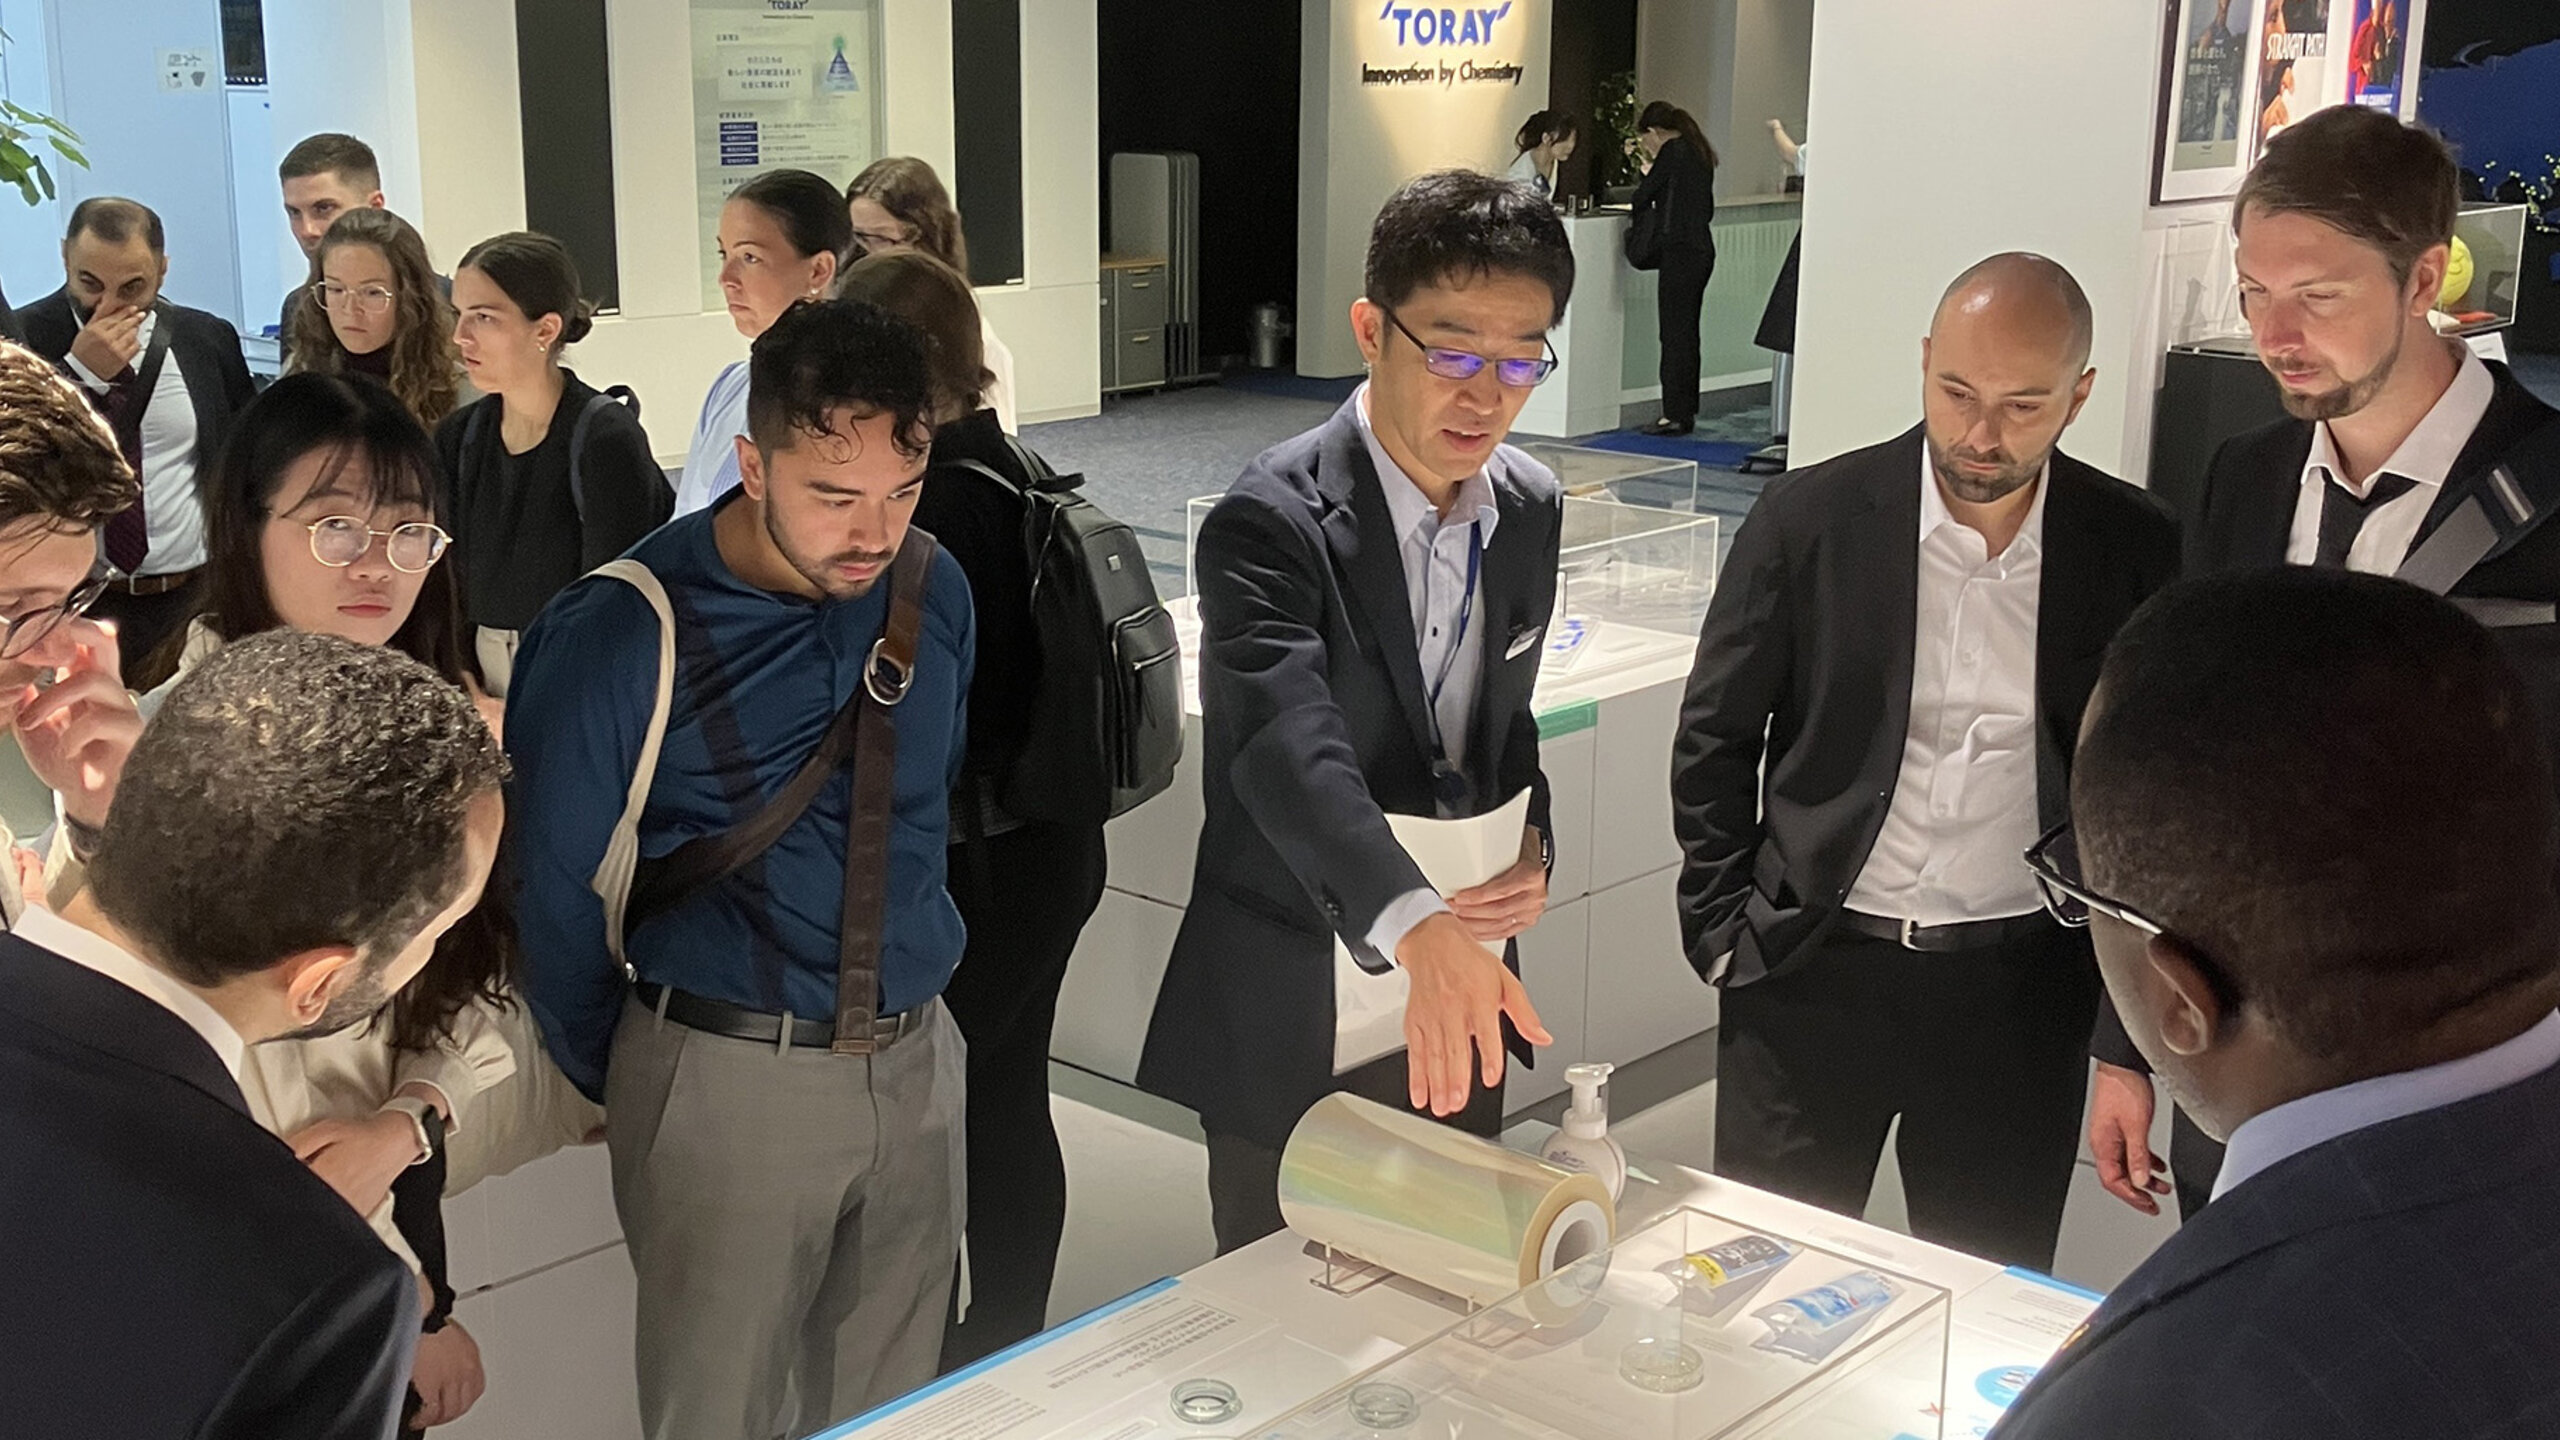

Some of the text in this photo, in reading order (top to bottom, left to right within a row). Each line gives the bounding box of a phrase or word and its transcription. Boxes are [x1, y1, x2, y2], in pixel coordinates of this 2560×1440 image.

[1362, 59, 1524, 90] Innovation by Chemistry
